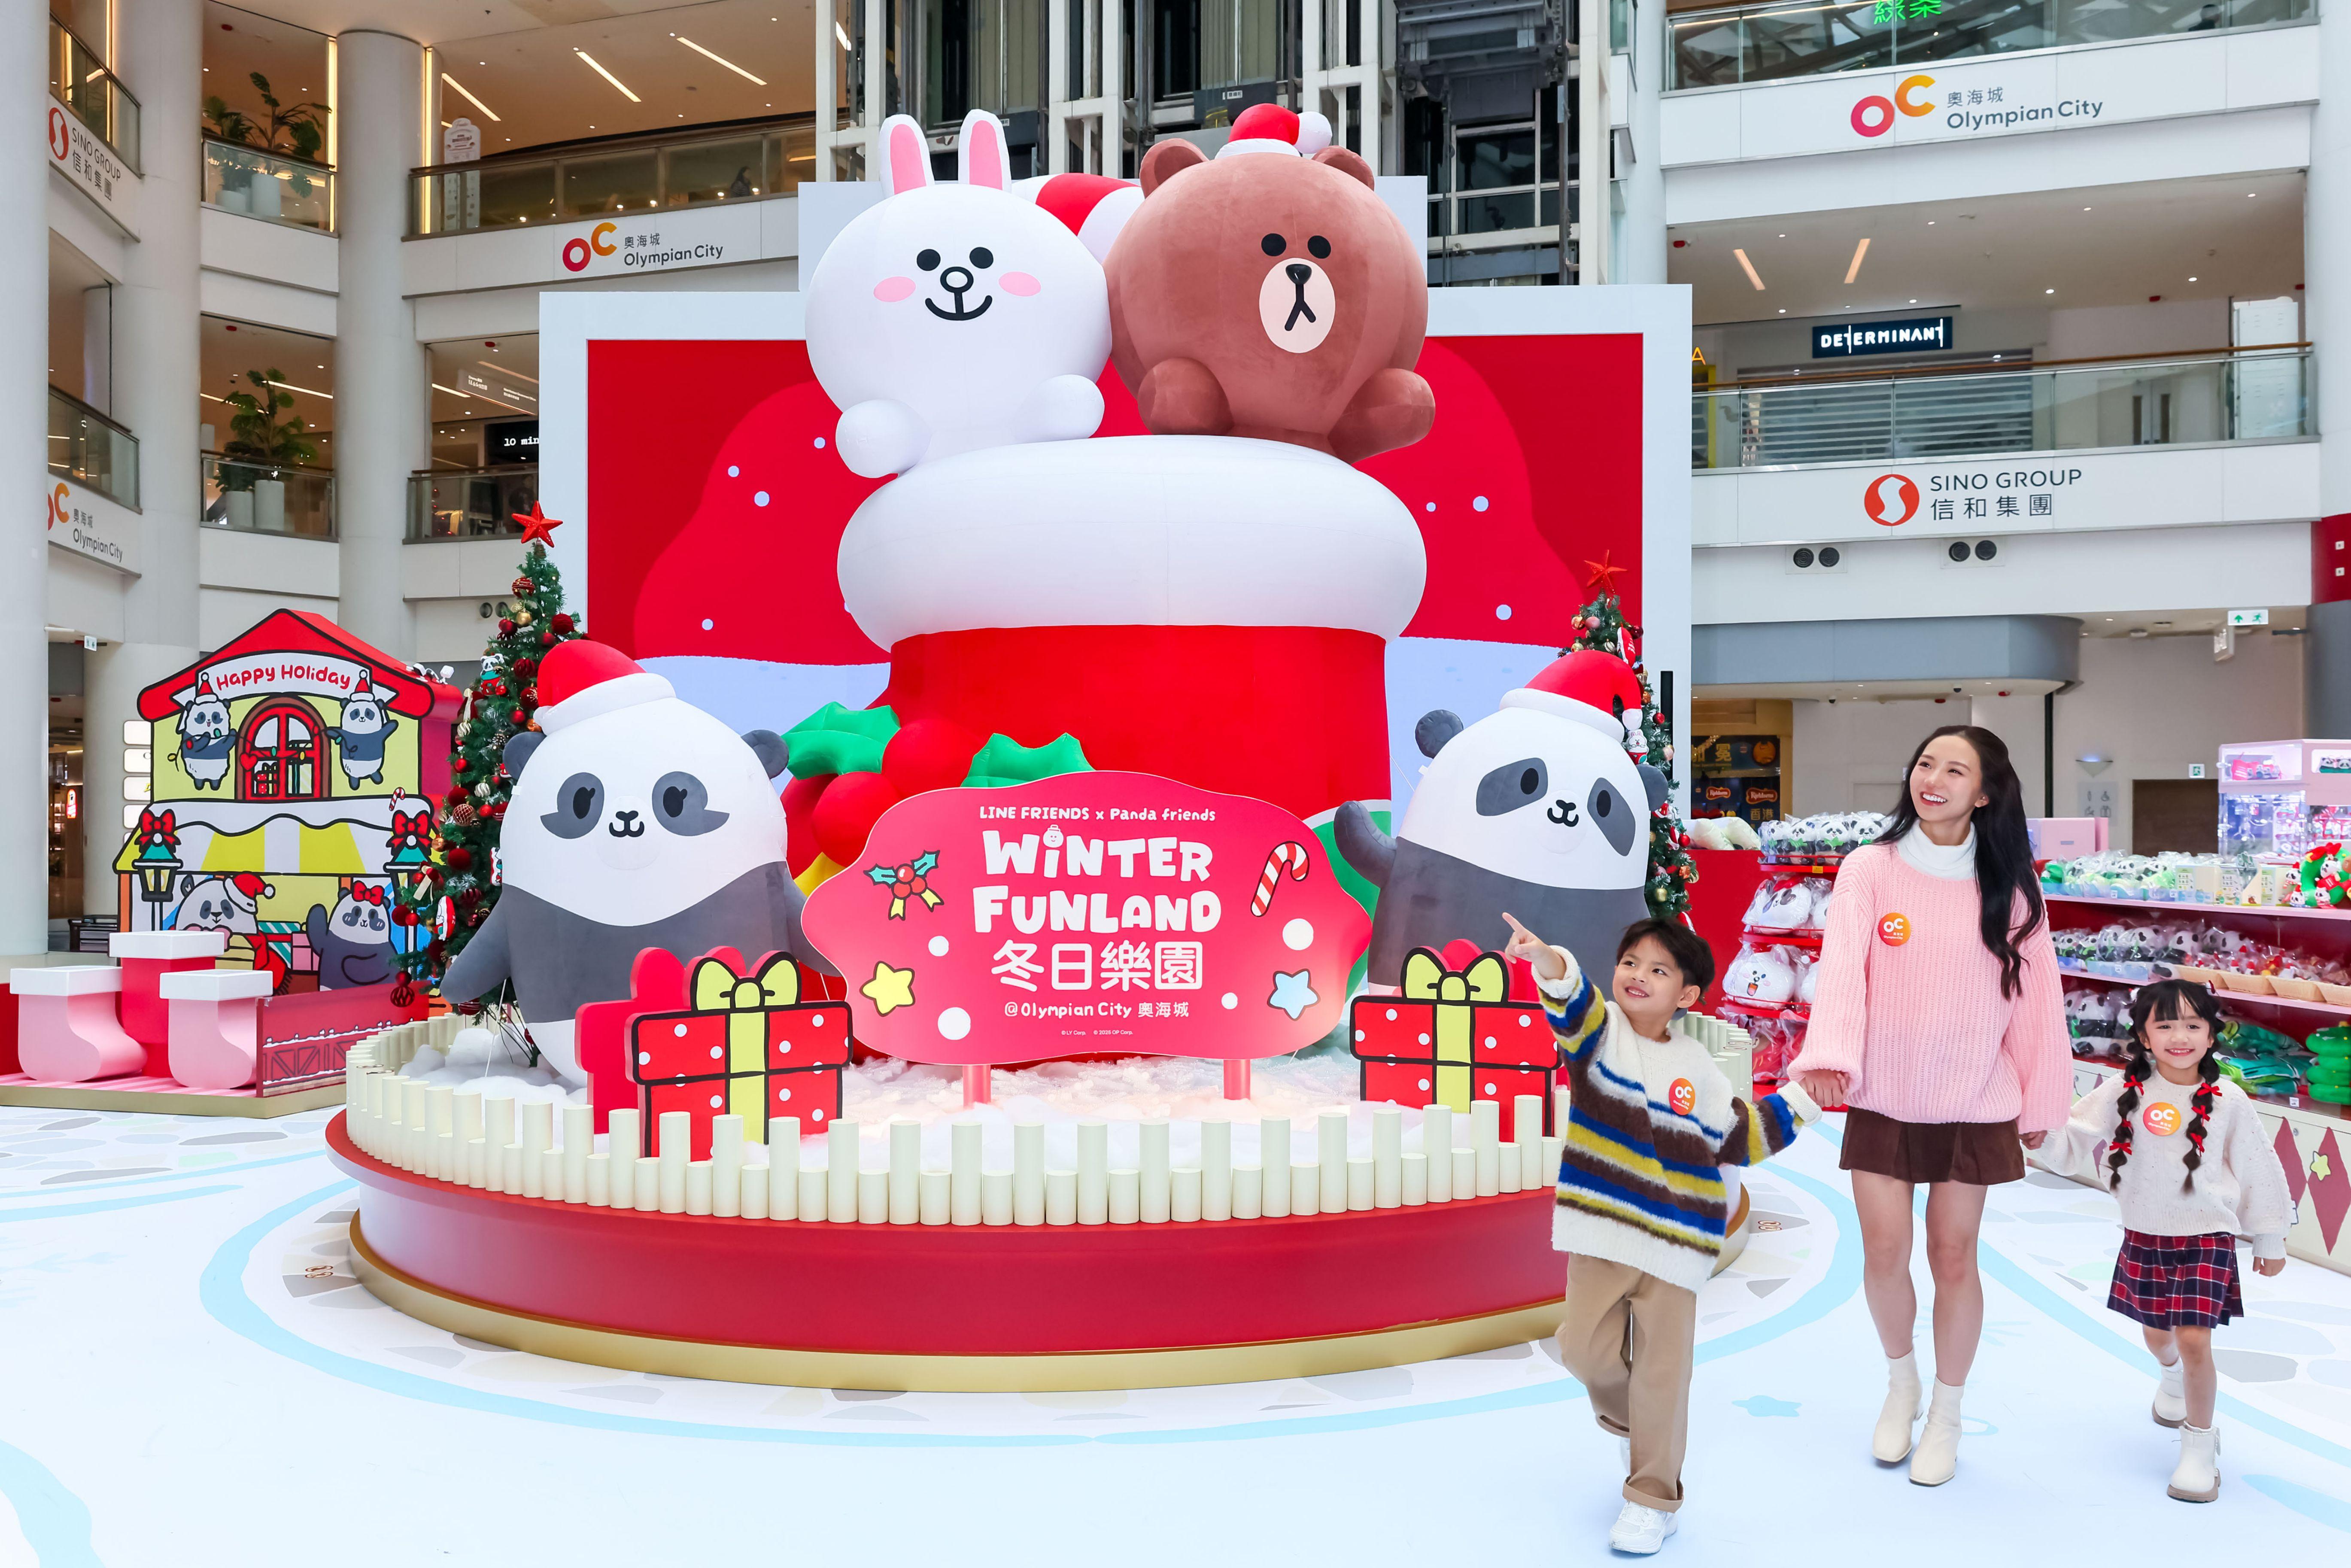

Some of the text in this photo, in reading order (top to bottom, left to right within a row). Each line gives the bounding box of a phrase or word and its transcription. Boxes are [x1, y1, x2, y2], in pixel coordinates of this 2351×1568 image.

[1851, 75, 1935, 137] OC
[1947, 87, 2004, 108] 奧海城
[1947, 100, 2103, 130] Olympian City
[72, 127, 121, 182] SINO GROUP
[73, 149, 112, 201] 信和集團
[562, 222, 617, 272] OC
[624, 233, 660, 249] 奧海城
[624, 245, 723, 268] Olympian City
[1820, 318, 1944, 354] DETERMINANT
[1930, 469, 2082, 492] SINO GROUP
[1930, 494, 2052, 521] 信和集團
[73, 528, 123, 568] Olympian City
[216, 667, 275, 691] Happy
[980, 806, 1216, 821] LINE FRIENDS x Panda friends
[1750, 808, 1774, 821] 香港
[972, 885, 1221, 934] FUNLAND
[1883, 918, 1904, 933] OC
[991, 939, 1203, 992] 冬日樂園
[1098, 1002, 1132, 1018] City
[1138, 1001, 1189, 1018] 奧海城
[1675, 1086, 1692, 1098] OC
[2150, 1109, 2175, 1121] OC
